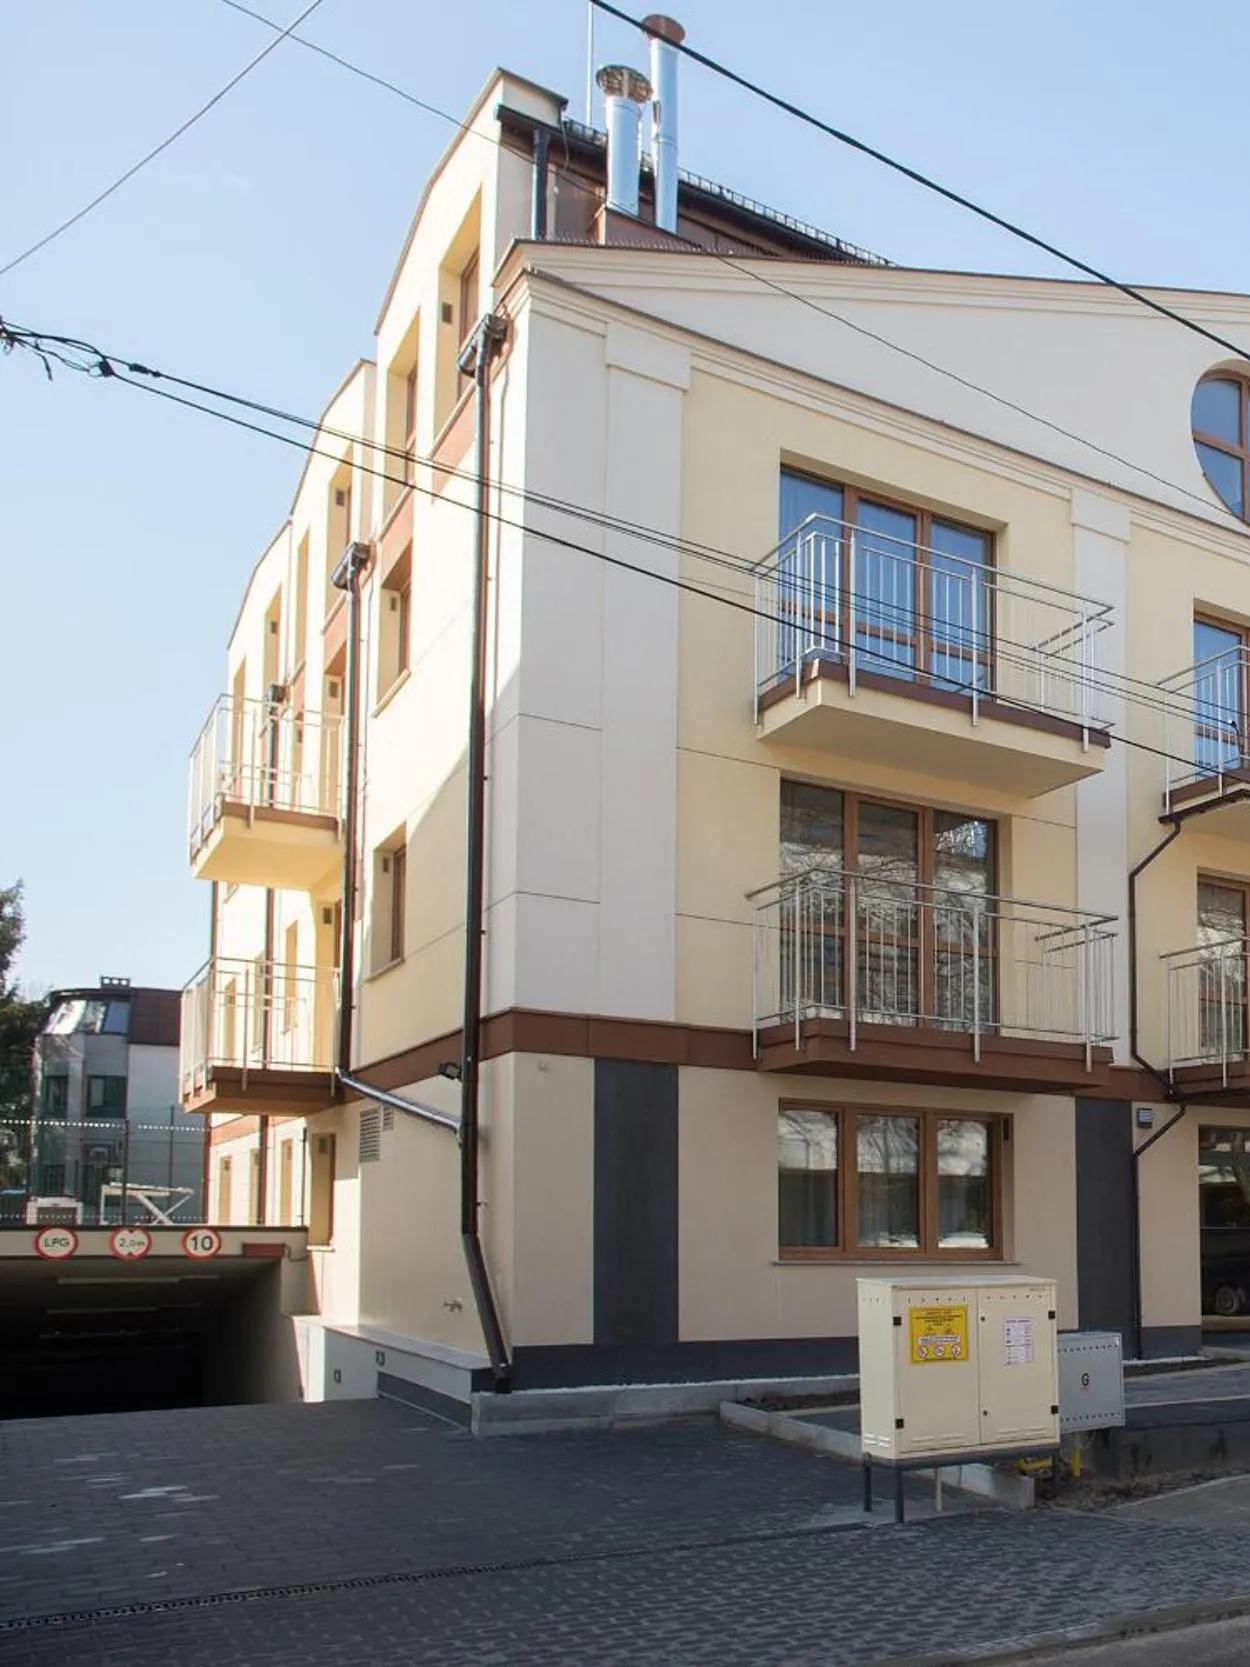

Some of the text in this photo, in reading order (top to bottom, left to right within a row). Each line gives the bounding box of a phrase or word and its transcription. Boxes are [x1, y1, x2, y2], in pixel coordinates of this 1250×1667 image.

[44, 1238, 70, 1248] LPG
[191, 1236, 213, 1251] 10
[1081, 1372, 1090, 1386] G
